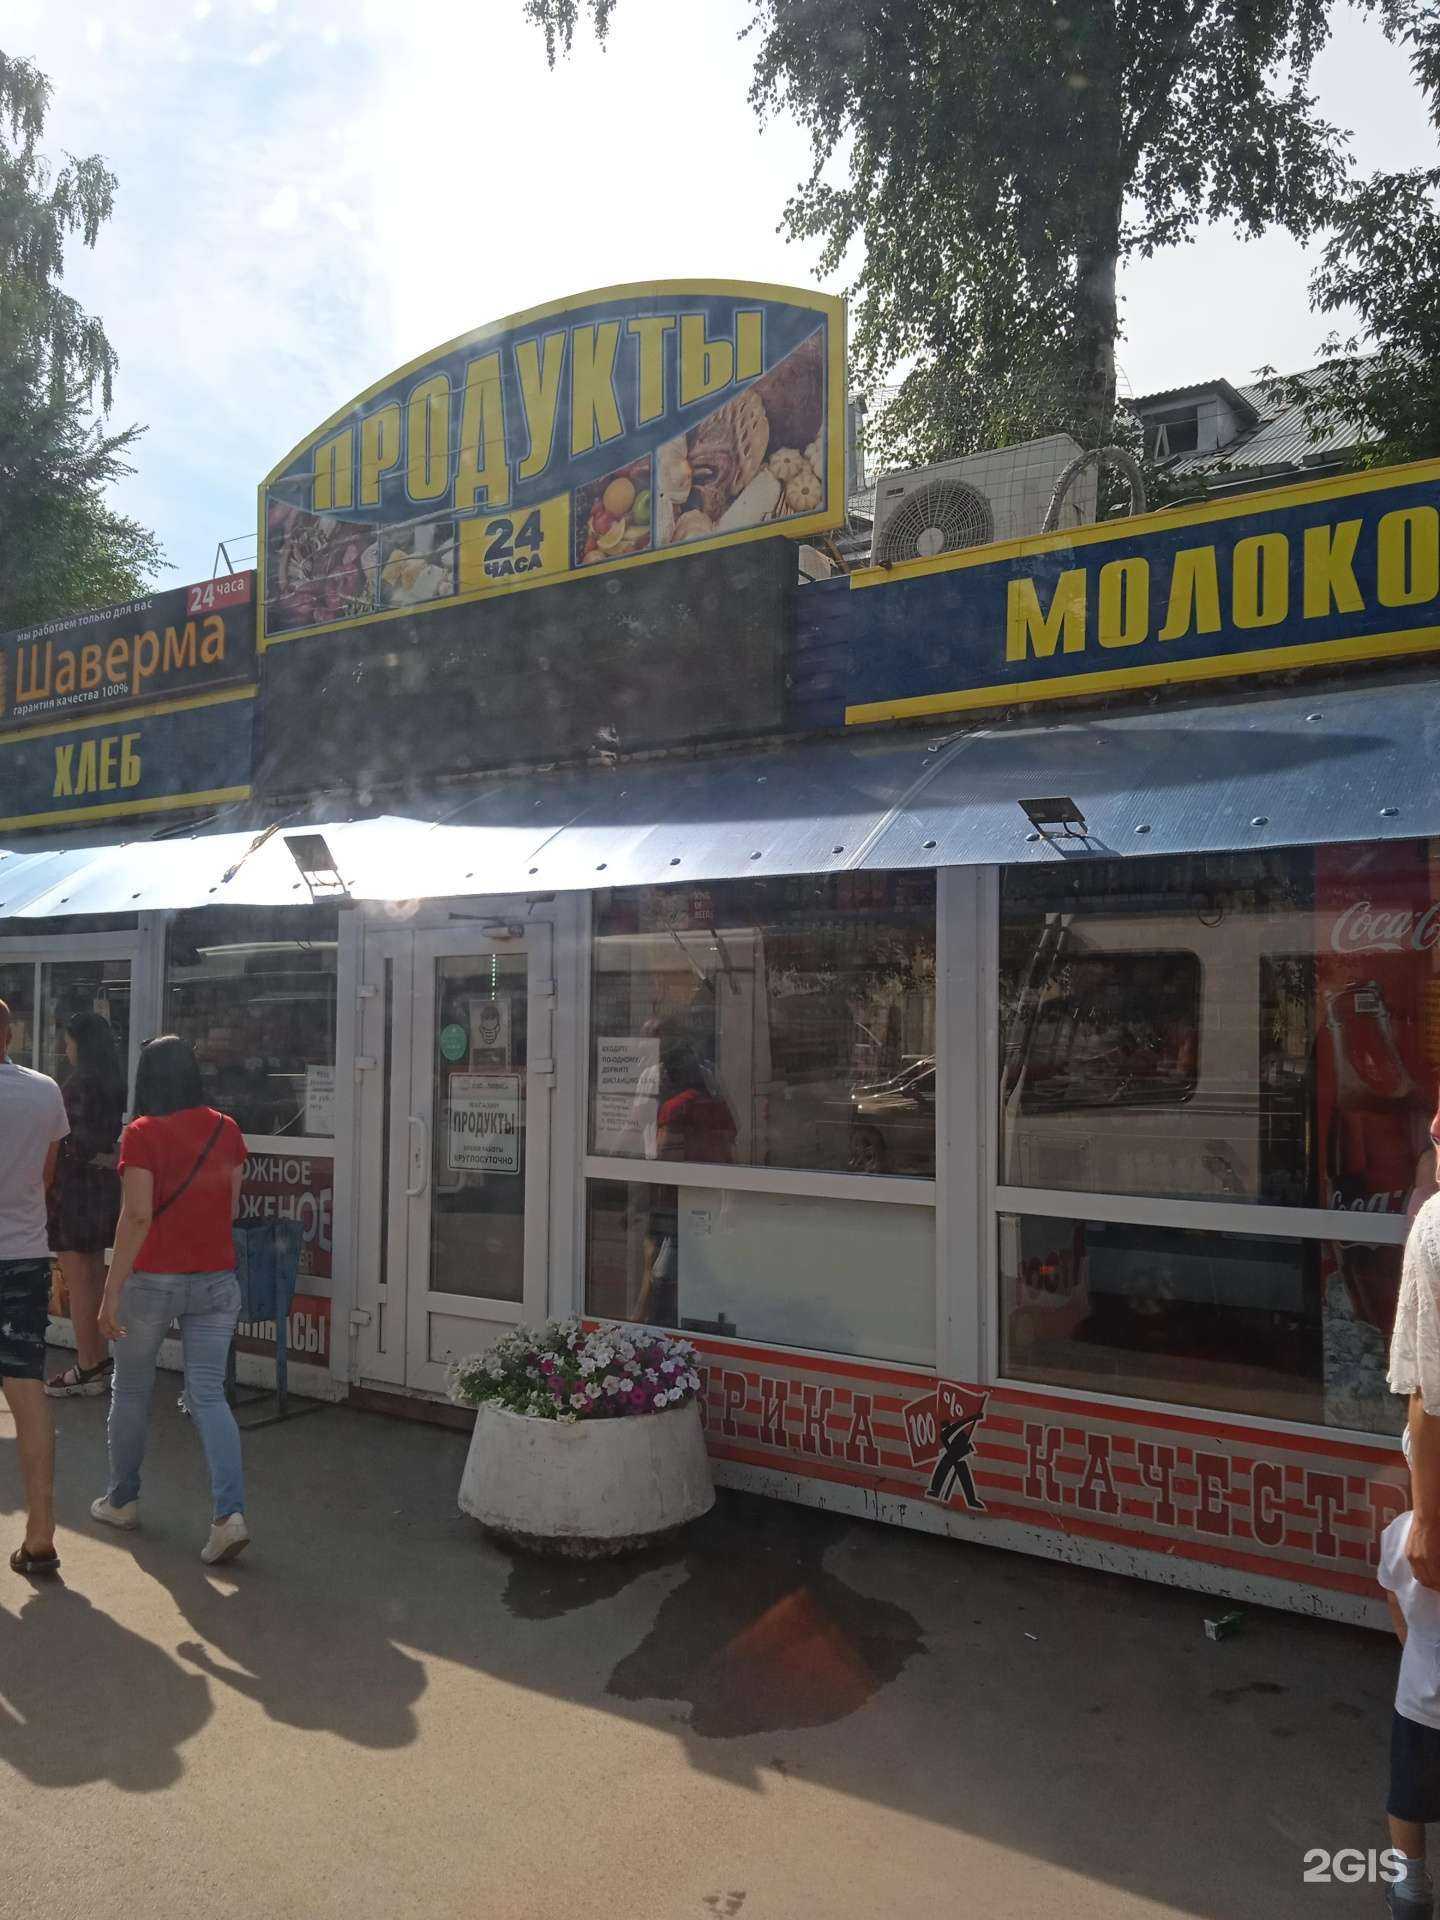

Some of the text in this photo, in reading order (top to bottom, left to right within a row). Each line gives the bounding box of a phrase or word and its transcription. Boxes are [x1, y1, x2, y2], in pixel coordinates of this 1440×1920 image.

[313, 308, 766, 512] ПРОДУКТЫ
[484, 517, 544, 561] 24
[484, 555, 544, 578] ЧАСА
[1005, 505, 1439, 662] МОЛОКО
[189, 577, 245, 613] 24 часа
[17, 600, 153, 642] мы работаем только для вас
[15, 614, 226, 704] Шаверма
[13, 682, 129, 716] гарантия качества 100%
[53, 732, 142, 798] ХЛЕБ
[453, 1111, 515, 1138] ПРОДУКТЫ
[909, 1411, 936, 1448] 100
